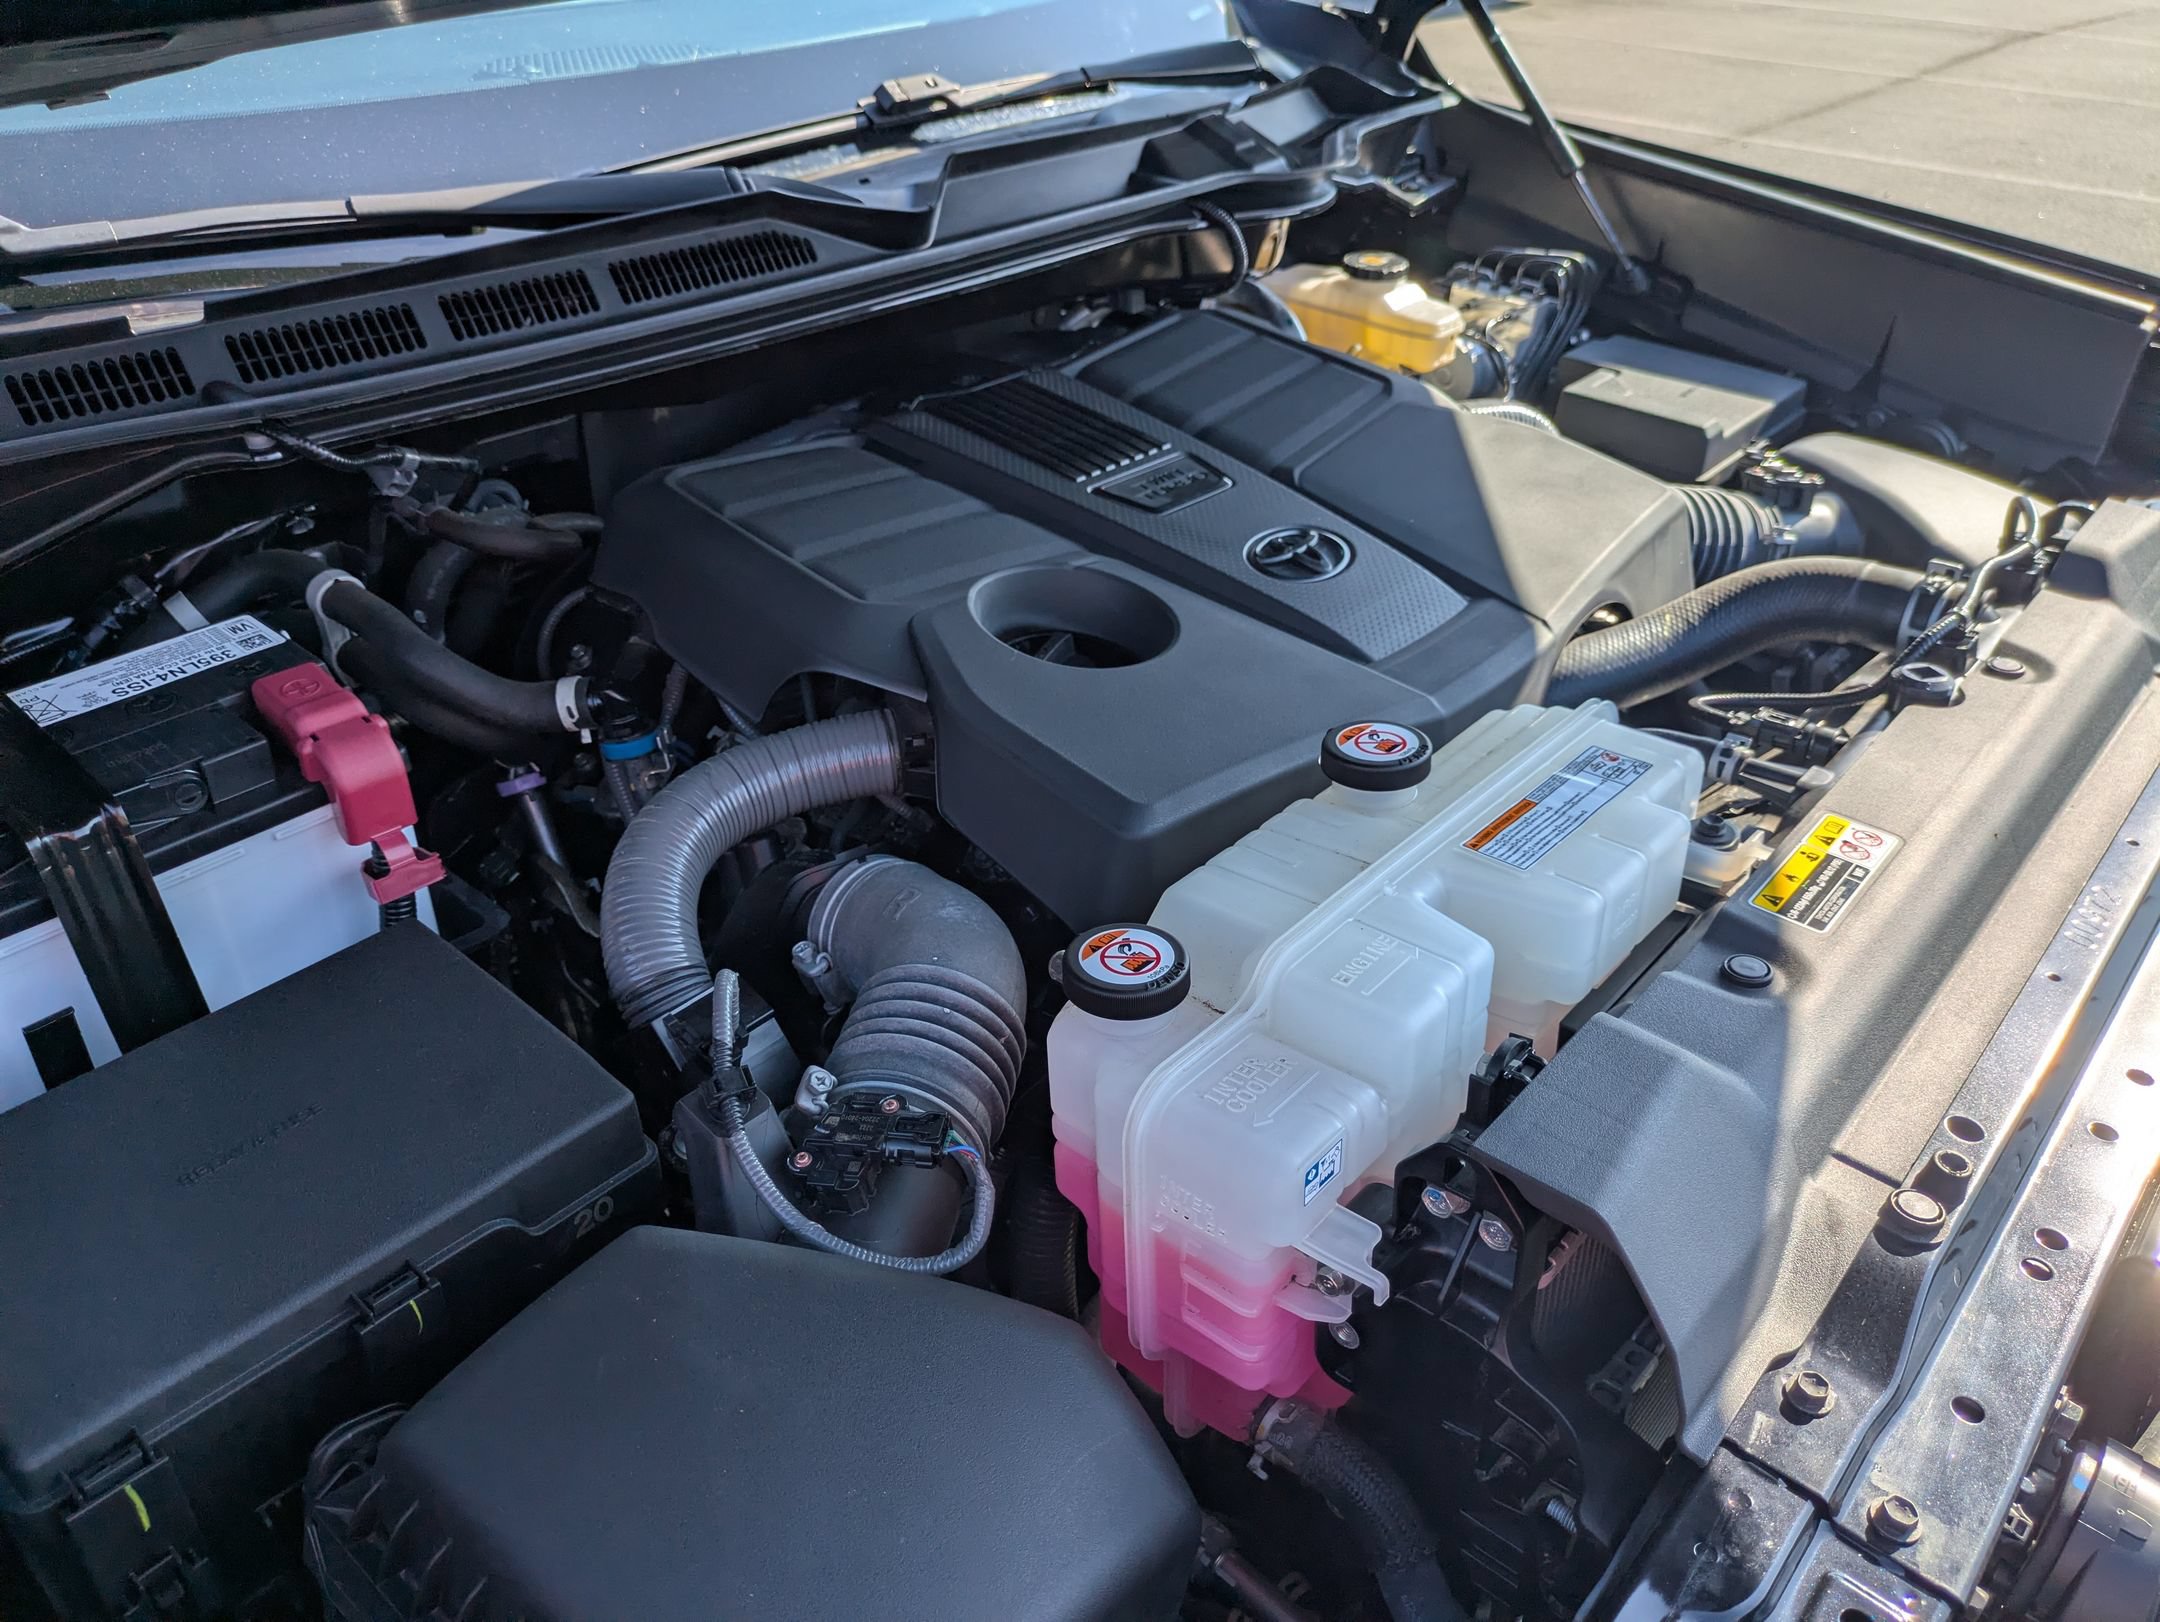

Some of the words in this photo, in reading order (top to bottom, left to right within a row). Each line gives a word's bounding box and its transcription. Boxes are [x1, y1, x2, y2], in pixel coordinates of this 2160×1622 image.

[228, 623, 253, 635] VM
[112, 649, 237, 698] 395LN4-ISS
[19, 695, 41, 704] Pb
[1145, 961, 1186, 991] DENSO
[1331, 933, 1397, 988] ENGINE
[1203, 1057, 1268, 1106] INTER
[1226, 1056, 1299, 1113] COOLER
[574, 1195, 614, 1239] 20
